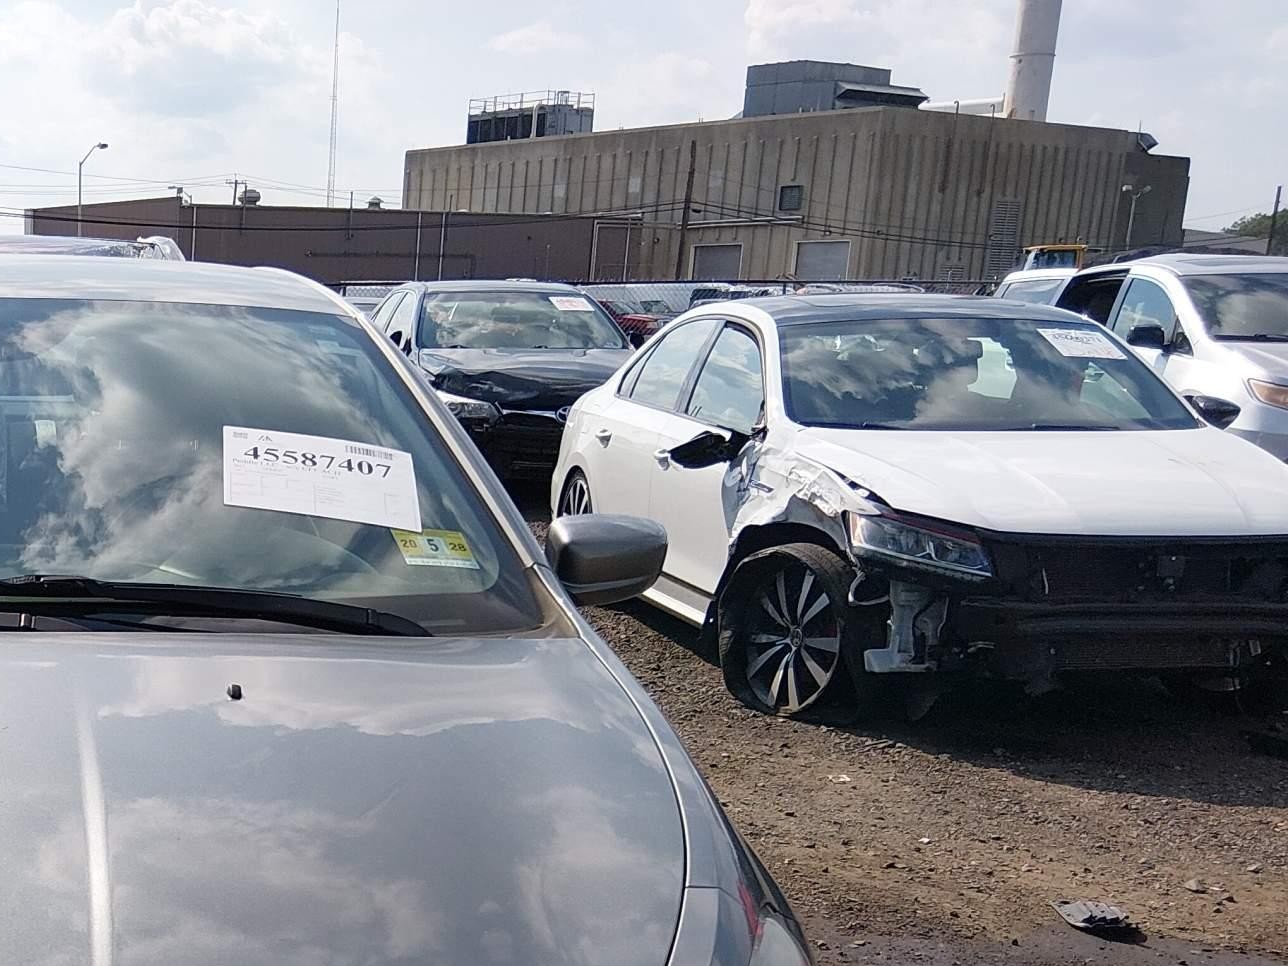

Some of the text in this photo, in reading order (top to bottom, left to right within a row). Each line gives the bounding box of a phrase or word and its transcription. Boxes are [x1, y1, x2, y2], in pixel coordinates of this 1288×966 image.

[243, 445, 392, 479] 45587407
[400, 539, 418, 549] 20
[426, 538, 439, 552] 5
